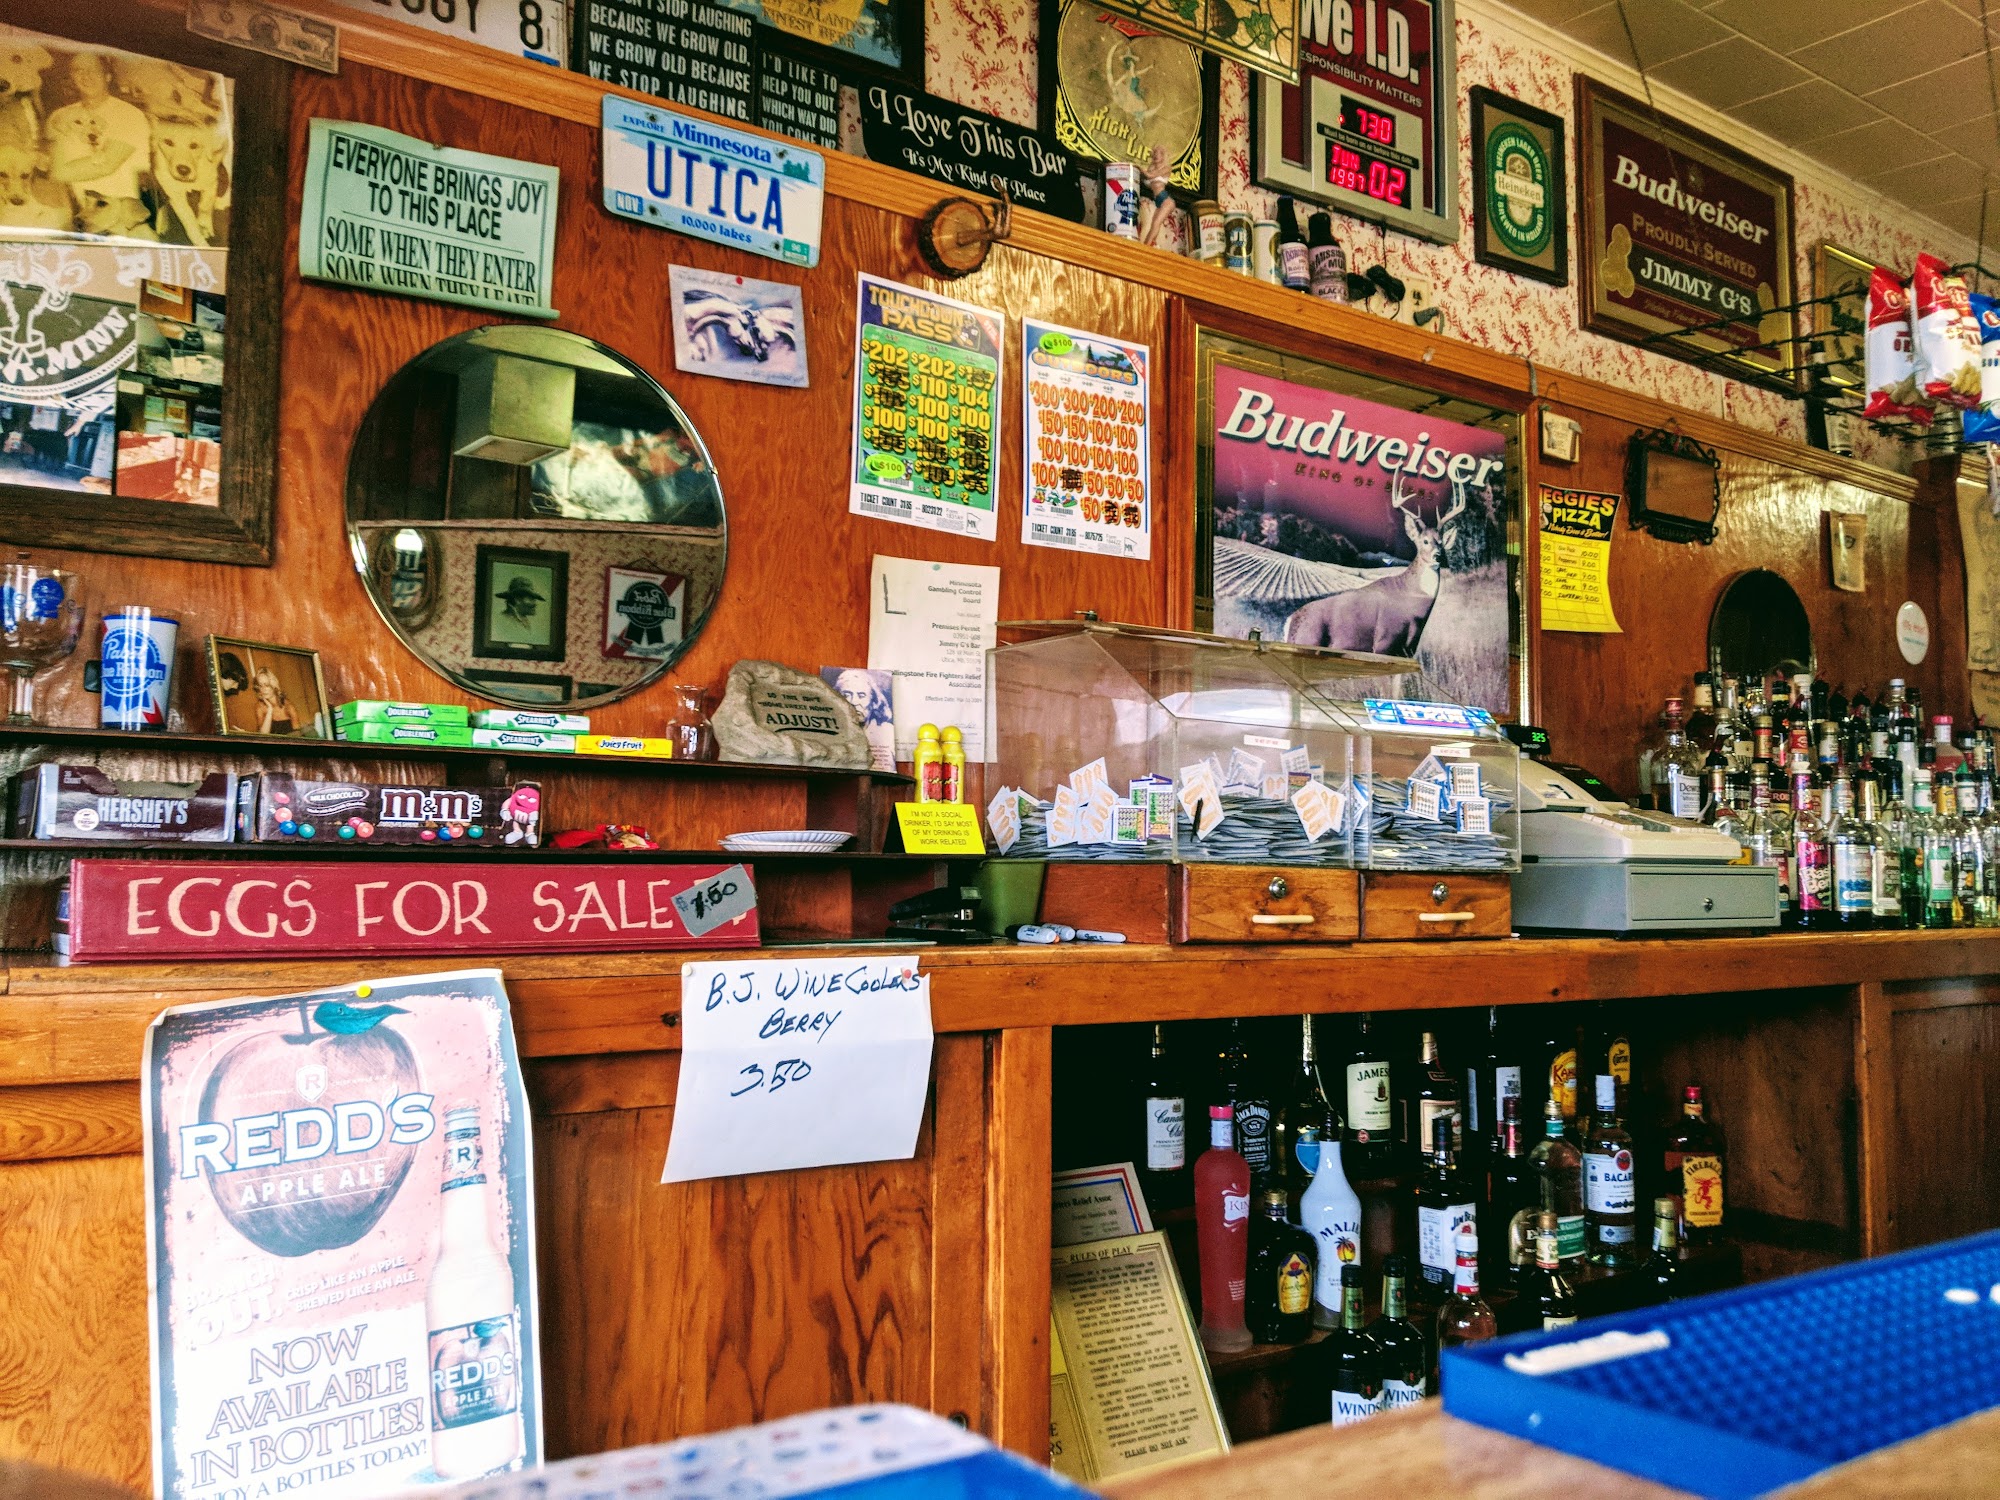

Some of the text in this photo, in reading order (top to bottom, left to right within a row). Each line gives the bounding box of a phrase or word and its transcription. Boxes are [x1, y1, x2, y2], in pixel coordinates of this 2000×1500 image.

[590, 3, 651, 38] BECAUSE
[656, 21, 676, 46] WE
[680, 28, 720, 57] GROW
[692, 7, 751, 38] LAUGHING
[1301, 0, 1419, 85] We I.D.
[589, 31, 750, 93] WE GROW OLD BECAUSE
[762, 52, 837, 93] I'D LIKE TO
[1300, 52, 1373, 88] ESPONSIBILITY
[588, 60, 750, 121] WE STOP LAUGHING.
[762, 74, 837, 114] HELP YOU OUT.
[762, 96, 837, 135] WHICH WAY DID
[868, 86, 1067, 178] I Love This Bar
[1356, 107, 1393, 144] 730
[672, 120, 772, 163] Minnesota
[762, 117, 837, 151] YOU COME IN?
[1126, 133, 1152, 161] LIF
[333, 136, 543, 214] EVERYONE BRINGS JOY
[647, 139, 784, 235] UTICA
[902, 147, 926, 168] It's
[926, 155, 953, 183] My
[955, 162, 988, 189] Kind
[1010, 179, 1046, 203] Place
[1330, 166, 1366, 192] 1997
[1368, 161, 1406, 205] 02
[1498, 175, 1541, 201] Heineken
[368, 181, 502, 240] TO THIS PLACE
[1612, 154, 1769, 246] Budweiser
[719, 224, 753, 243] lakes
[1632, 213, 1757, 279] PROUDLY SERVED
[325, 216, 536, 293] SOME WHEN THEY ENTER
[325, 253, 374, 283] SOME
[380, 264, 431, 290] WHEN
[435, 277, 482, 299] THEY
[1640, 257, 1752, 316] JIMMY G'S
[868, 284, 964, 326] TOUCHDOWN
[46, 306, 137, 375] MINN.
[881, 307, 953, 343] PASS
[862, 339, 909, 368] $202
[912, 374, 948, 400] $110
[951, 384, 989, 410] $104
[1030, 381, 1117, 421] $300 $200
[909, 395, 949, 421] $100
[1038, 410, 1063, 436] $150
[1217, 386, 1503, 488] Budweiser
[1084, 470, 1104, 496] $50
[1553, 507, 1601, 530] PIZZA
[928, 585, 981, 596] Gambling Control
[931, 623, 959, 631] Premises
[925, 670, 937, 679] Fire
[939, 671, 963, 681] Fighters
[948, 681, 981, 689] Association
[387, 707, 430, 718] DOUBLEMINT
[517, 714, 558, 726] SPEARMINT
[766, 712, 840, 730] ADJUST!
[393, 728, 437, 740] DOUBLEMINT
[501, 734, 542, 747] SPEARMINT
[599, 739, 643, 750] Juicy Fruit
[98, 797, 189, 824] HERSHEY'S
[941, 811, 963, 819] SOCIAL
[956, 820, 973, 828] MOST
[934, 829, 962, 837] DRINKING
[940, 838, 967, 846] RELATED
[127, 877, 673, 938] EGGS FOR SALE
[759, 1007, 842, 1043] BERRY
[304, 1073, 321, 1090] R
[1357, 1067, 1389, 1082] JAMES
[180, 1092, 435, 1179] REDD'S
[240, 1163, 387, 1205] APPLE ALE
[1070, 1245, 1133, 1263] RULES OF PLAY
[286, 1281, 317, 1302] CRISP
[319, 1273, 346, 1291] LIKE
[350, 1268, 366, 1283] AN
[295, 1291, 343, 1313] BREWED
[346, 1284, 370, 1302] LIKE
[372, 1279, 392, 1295] AN
[249, 1324, 369, 1385] NOW
[206, 1357, 409, 1441] AVAILABLE
[191, 1397, 426, 1489] IN BOTTLES!
[257, 1438, 429, 1497] A BOTTLES TODAY!
